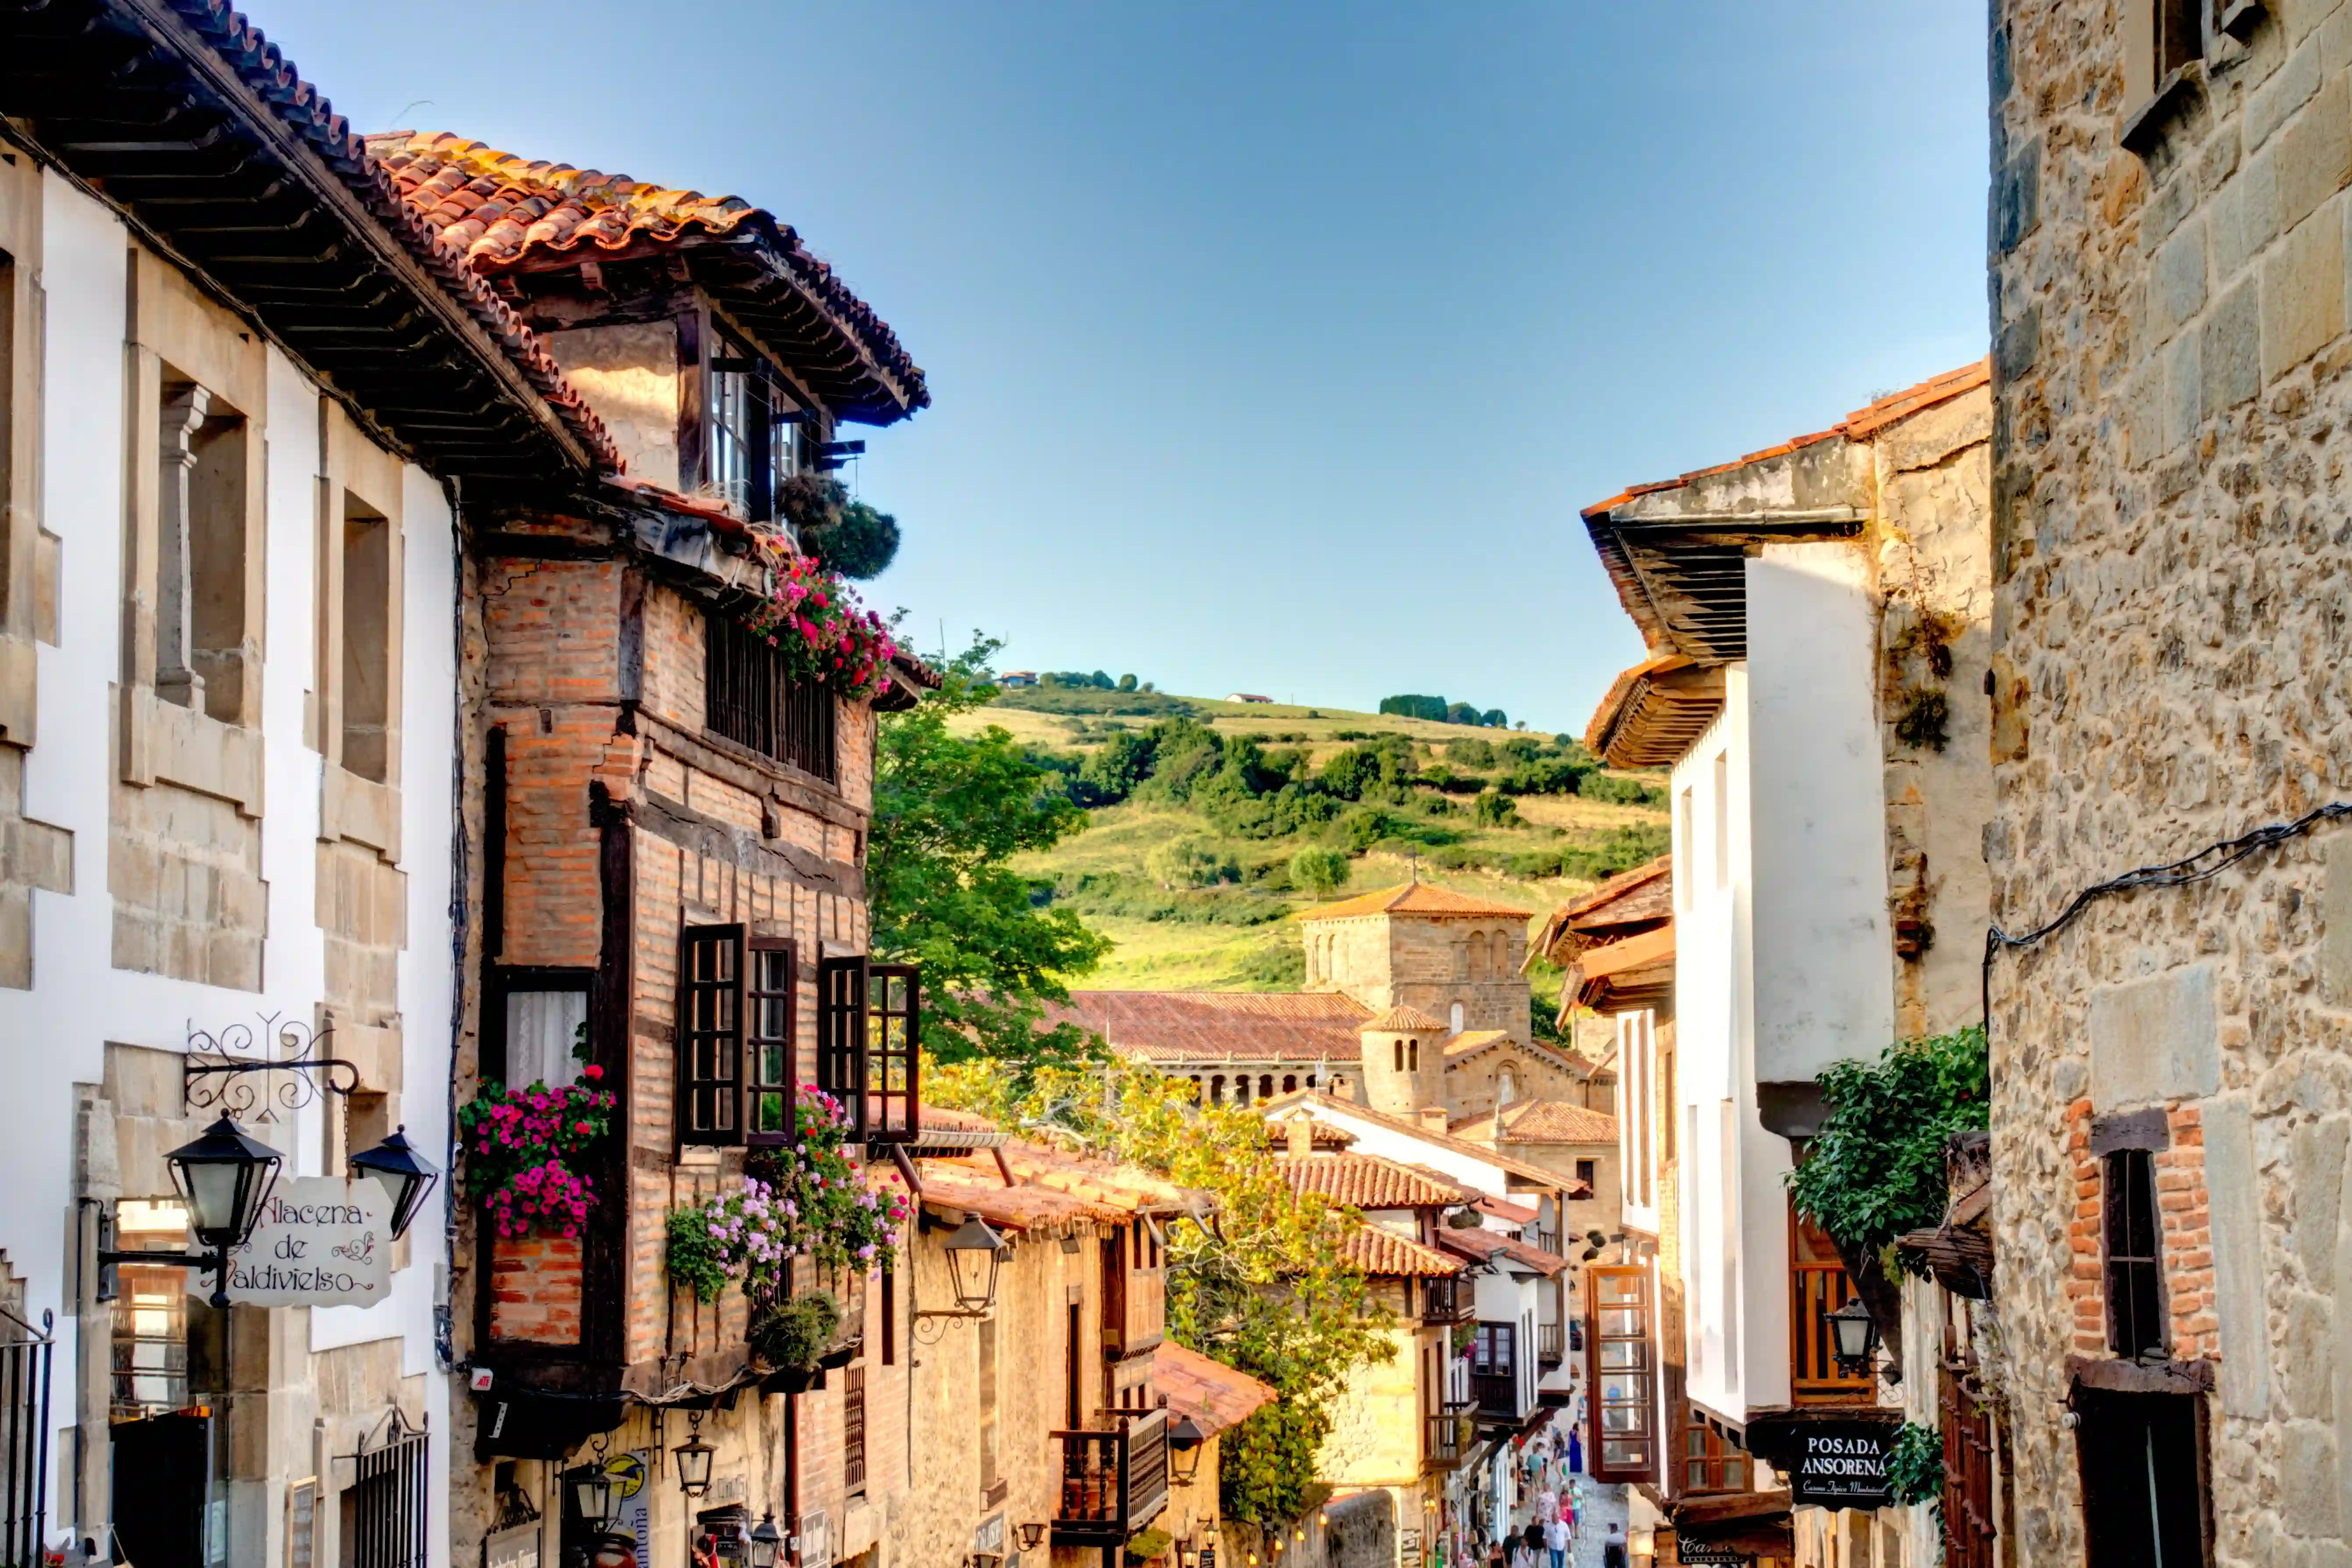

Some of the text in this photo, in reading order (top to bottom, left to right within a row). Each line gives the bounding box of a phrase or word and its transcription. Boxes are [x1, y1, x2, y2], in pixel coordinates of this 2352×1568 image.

[257, 1196, 363, 1228] Alacena
[275, 1234, 308, 1262] de
[1808, 1437, 1880, 1455] POSADA
[1801, 1458, 1887, 1477] ANSORENA
